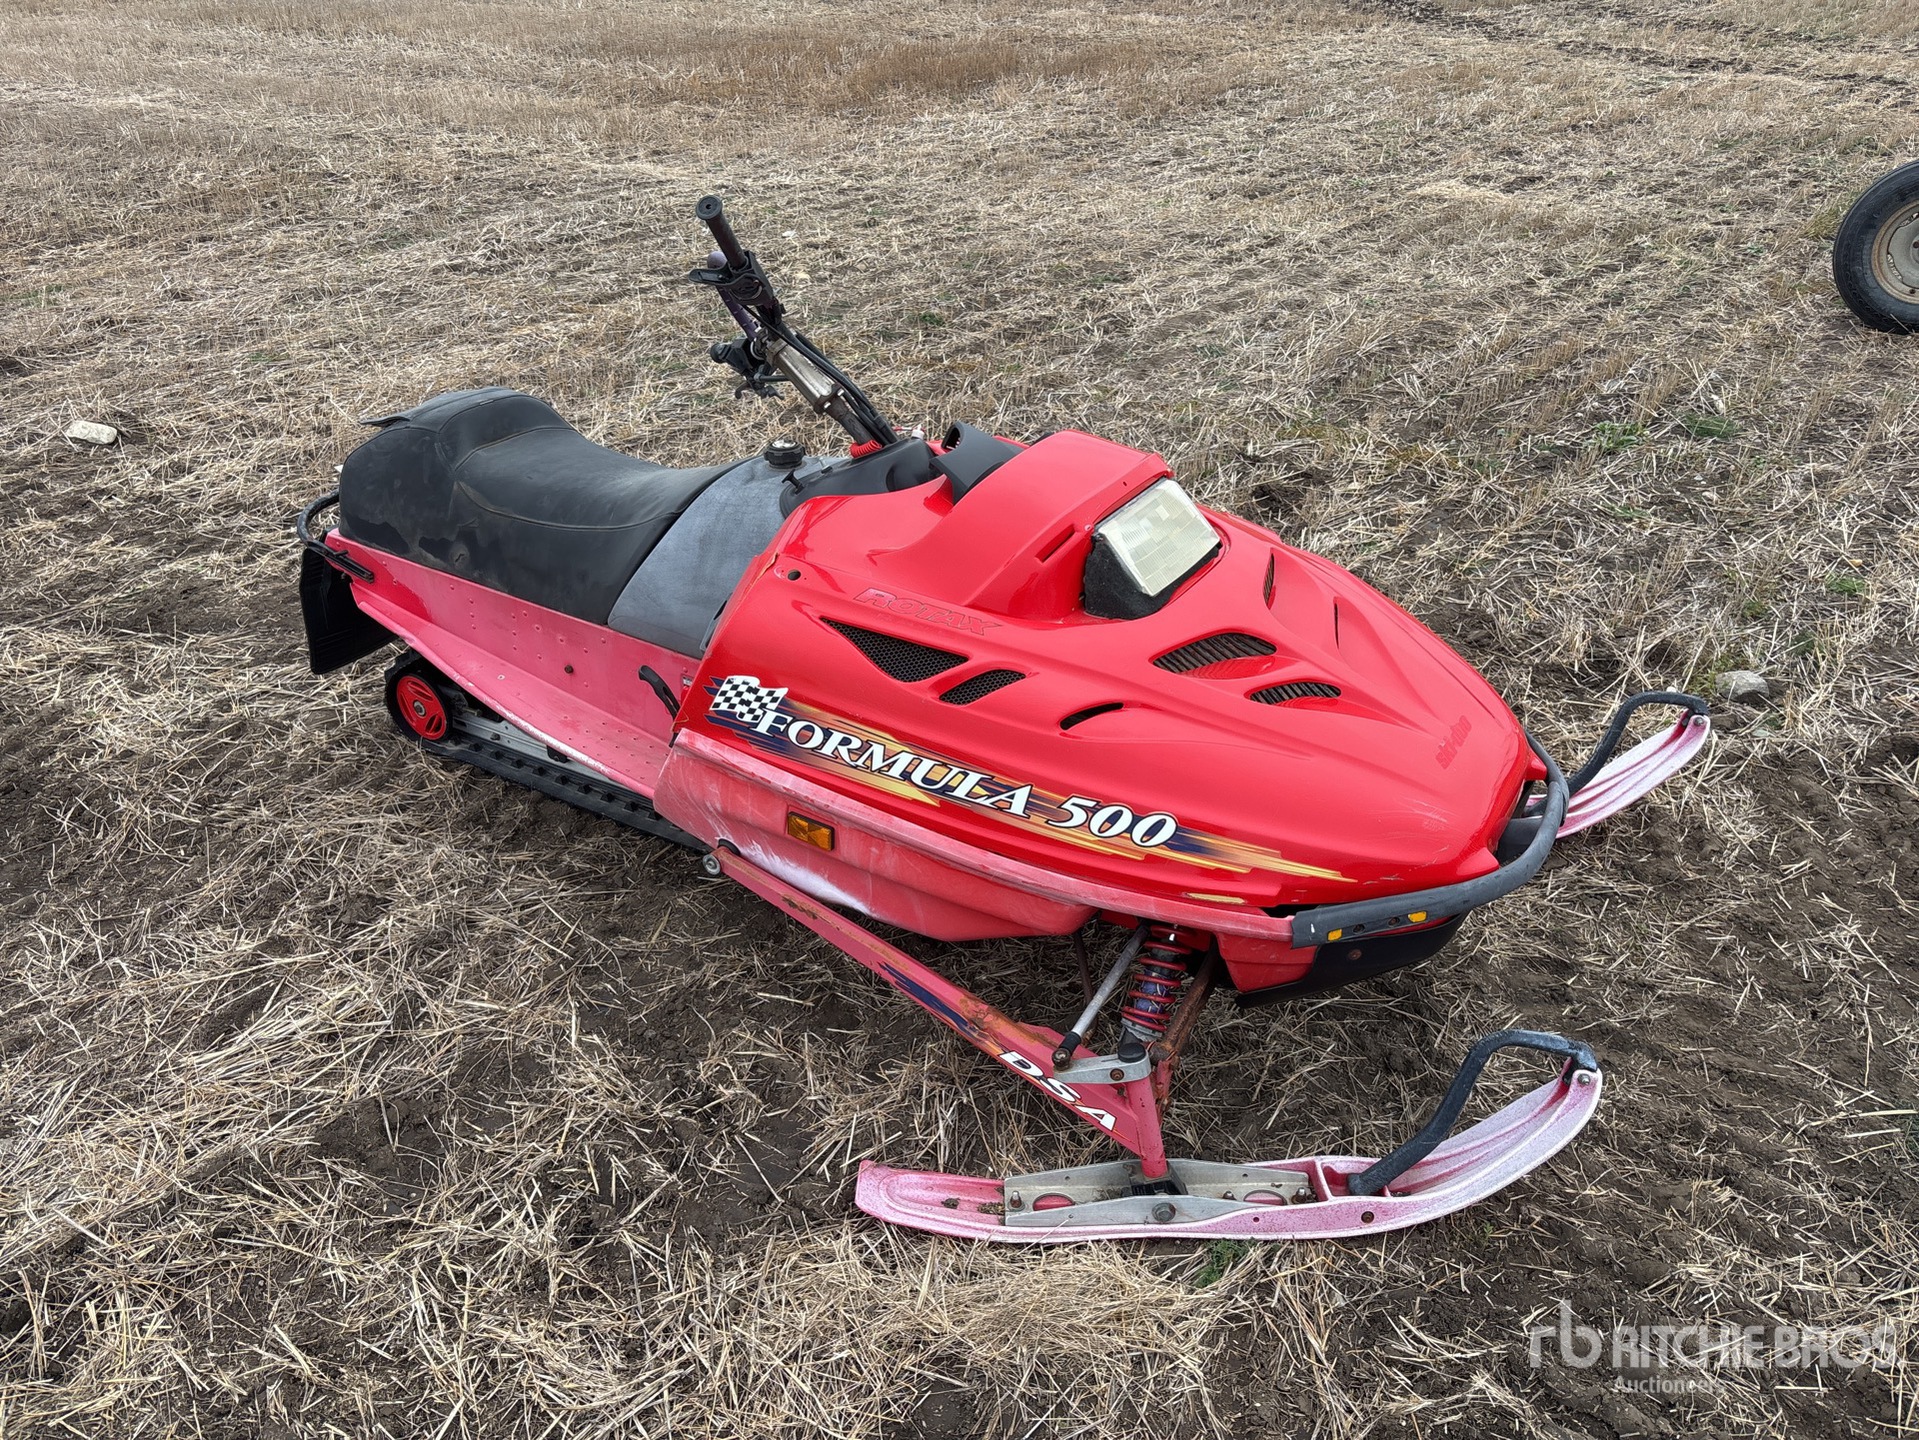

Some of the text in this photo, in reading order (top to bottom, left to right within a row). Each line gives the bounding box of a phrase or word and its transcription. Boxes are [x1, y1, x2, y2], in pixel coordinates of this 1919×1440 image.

[853, 587, 1003, 636] ROTAX
[749, 707, 1180, 850] FORMULA 500
[998, 1050, 1117, 1132] DSA
